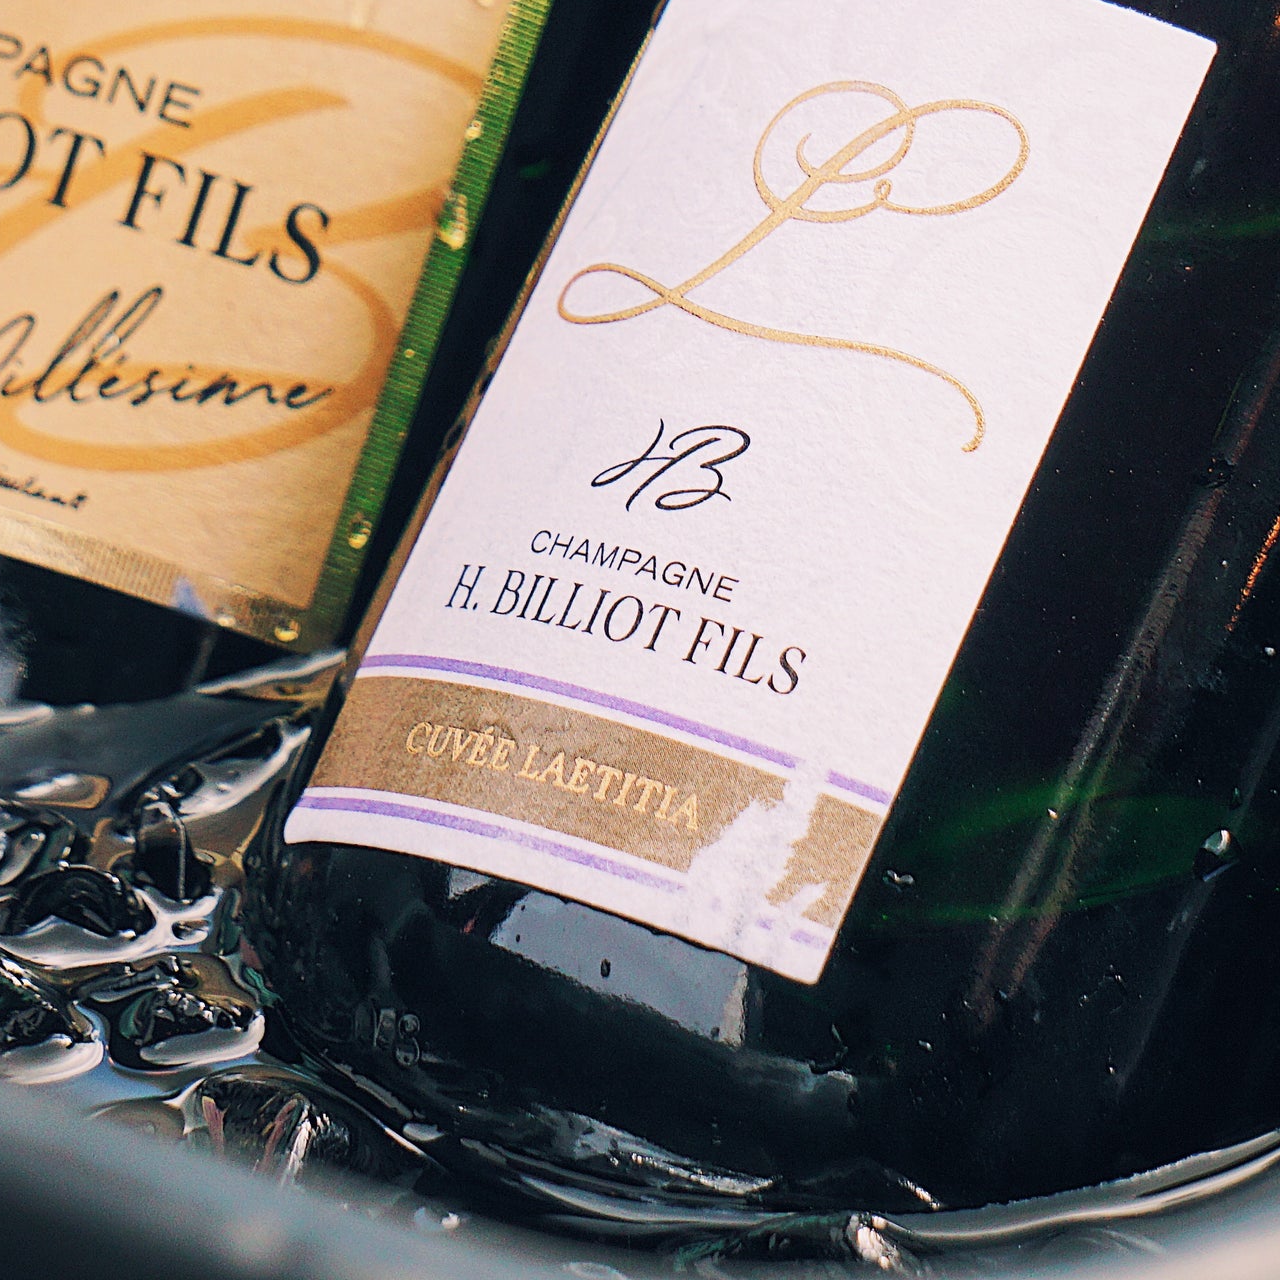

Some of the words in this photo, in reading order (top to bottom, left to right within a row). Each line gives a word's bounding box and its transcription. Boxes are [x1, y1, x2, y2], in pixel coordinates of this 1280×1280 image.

[116, 149, 333, 287] FILS
[590, 417, 752, 513] HB
[530, 529, 740, 603] CHAMPAGNE
[443, 563, 487, 611] H.
[489, 568, 682, 653] BILLIOT
[681, 615, 808, 696] FILS
[405, 720, 520, 772] CUVÉE
[514, 743, 700, 833] LAETITIA
